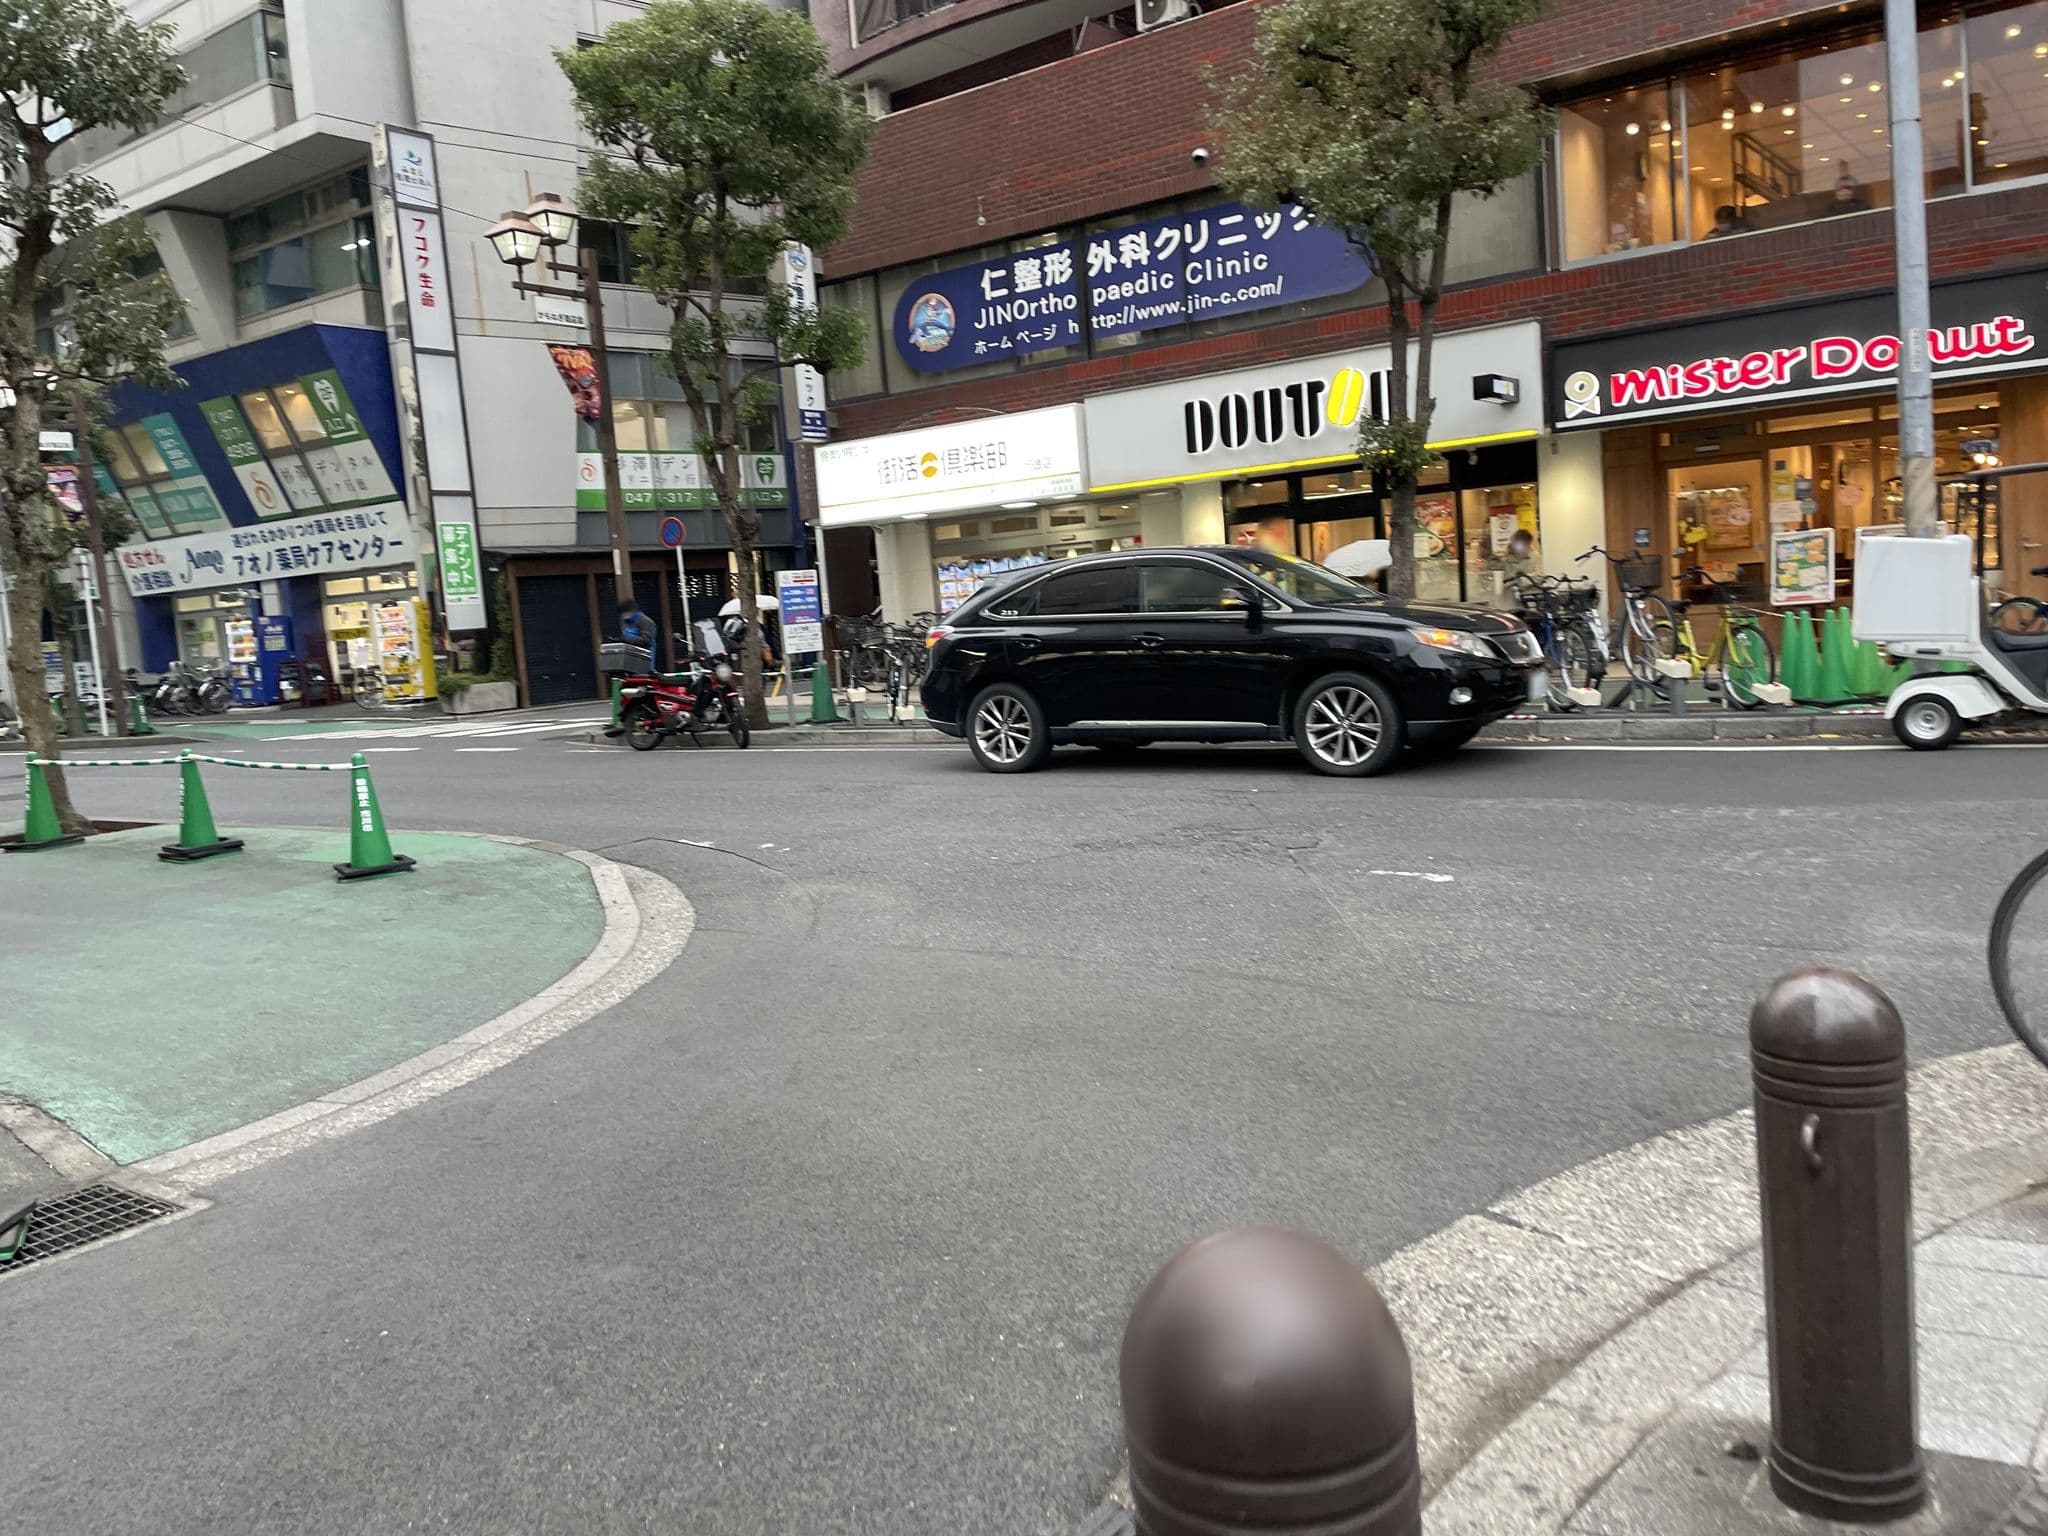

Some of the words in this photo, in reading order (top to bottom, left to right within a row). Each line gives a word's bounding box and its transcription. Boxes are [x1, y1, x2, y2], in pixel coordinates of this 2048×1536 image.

[412, 217, 435, 307] フコク生命
[1186, 251, 1268, 285] Clinic
[232, 534, 404, 577] アオノ薬局ケアセンター
[455, 526, 473, 585] テナント
